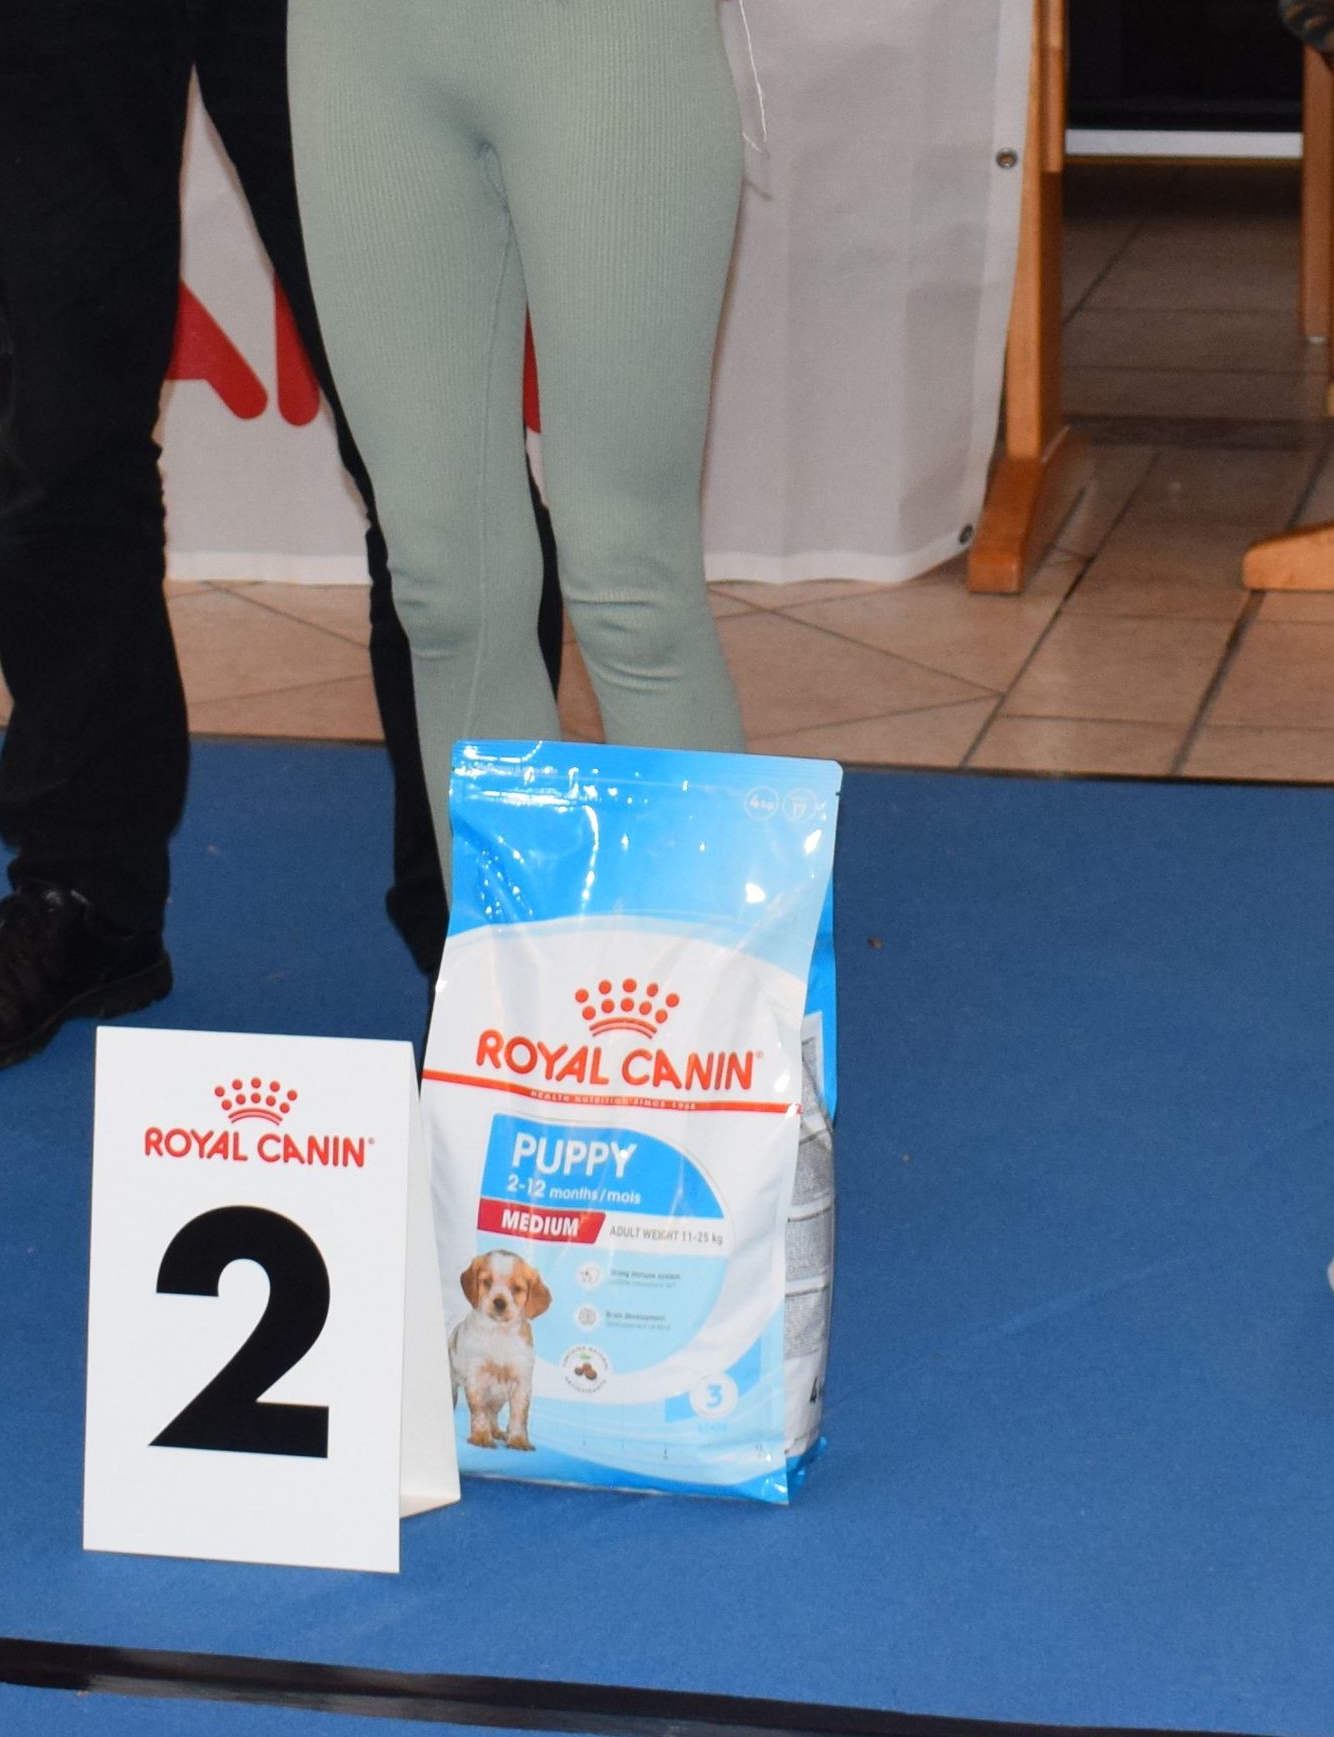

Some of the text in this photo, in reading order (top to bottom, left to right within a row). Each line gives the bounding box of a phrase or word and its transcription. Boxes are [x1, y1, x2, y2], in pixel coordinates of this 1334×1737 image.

[476, 1029, 754, 1091] ROYAL CANIN
[144, 1126, 366, 1168] ROYAL CANIN
[512, 1131, 638, 1179] PUPPY
[506, 1175, 545, 1198] 2-12
[500, 1208, 580, 1237] MEDIUM
[609, 1225, 724, 1247] ADULT WEIGHT 11-25 kg
[148, 1204, 332, 1459] 2
[705, 1383, 724, 1408] 3
